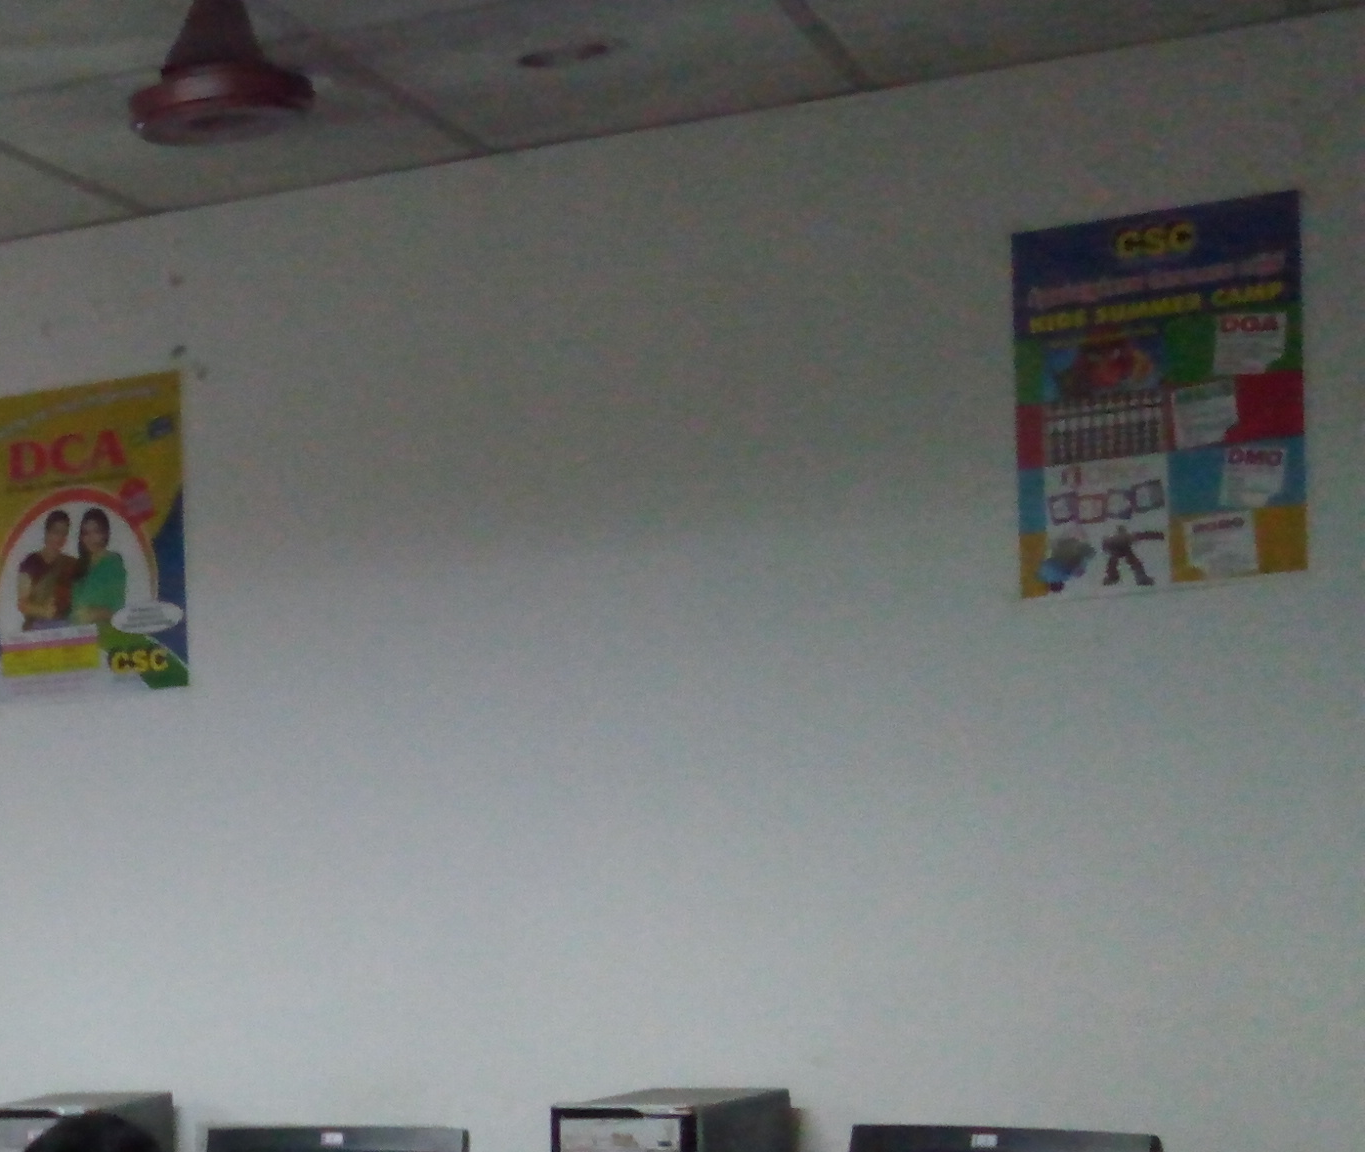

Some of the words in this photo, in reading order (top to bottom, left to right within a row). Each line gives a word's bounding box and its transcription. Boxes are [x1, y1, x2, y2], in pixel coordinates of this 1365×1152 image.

[1115, 223, 1195, 259] CSC
[8, 429, 127, 482] DCA
[110, 649, 169, 675] CSC
